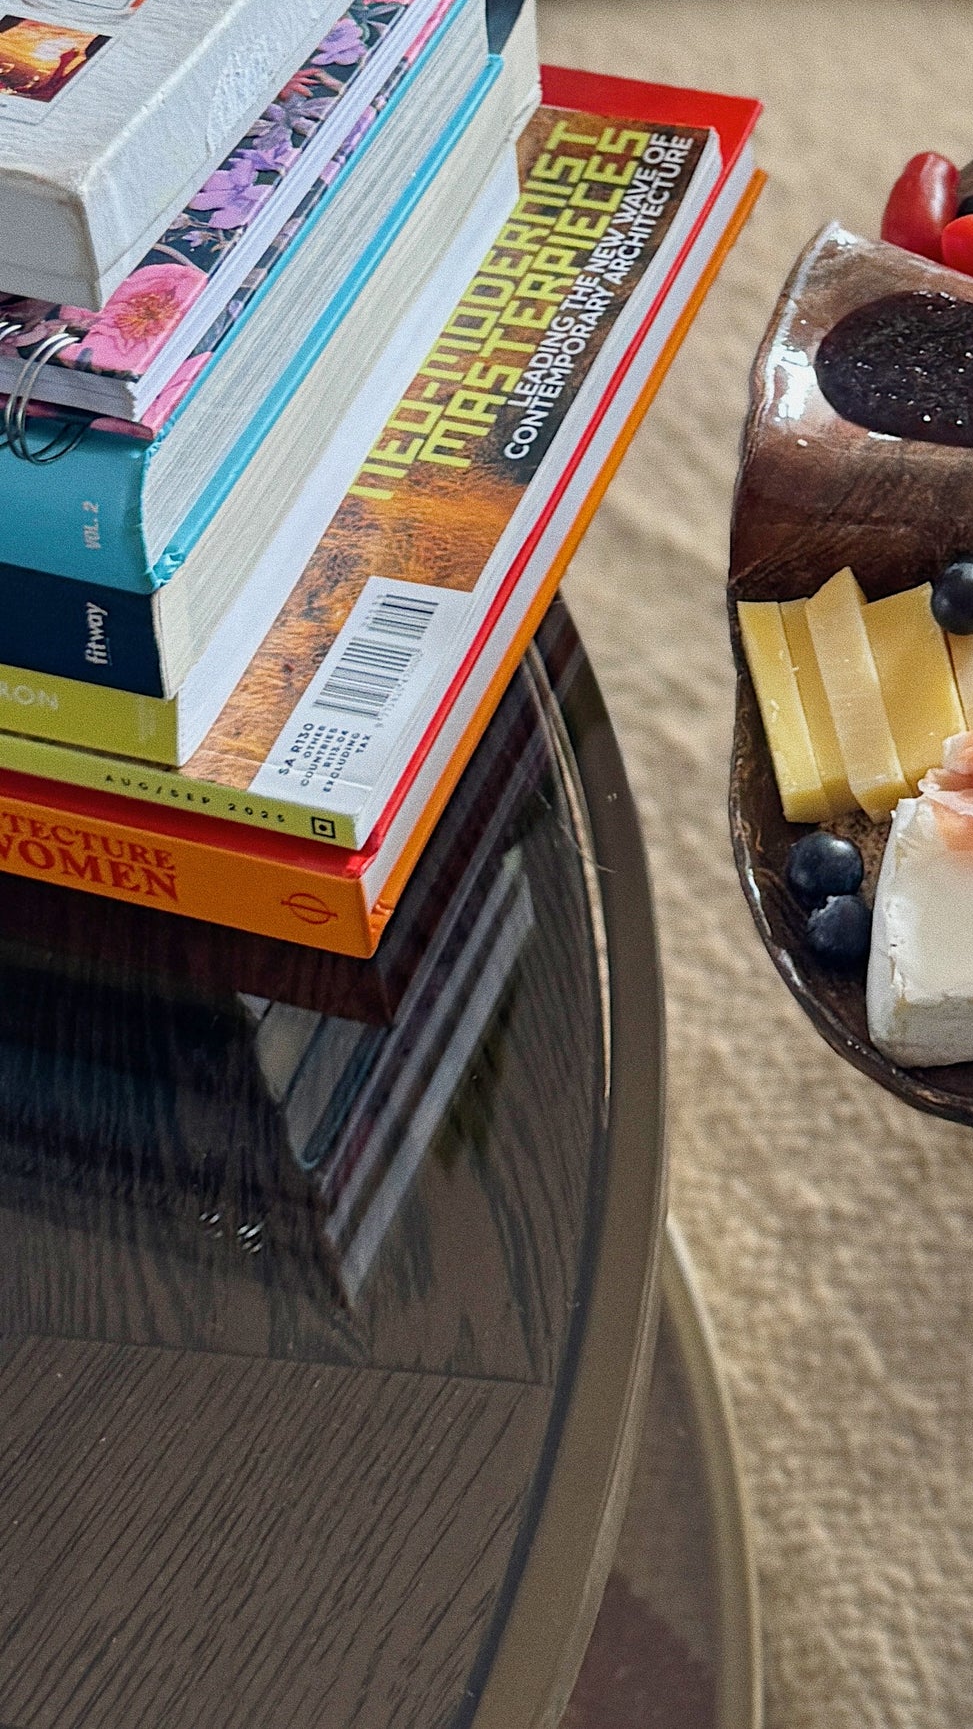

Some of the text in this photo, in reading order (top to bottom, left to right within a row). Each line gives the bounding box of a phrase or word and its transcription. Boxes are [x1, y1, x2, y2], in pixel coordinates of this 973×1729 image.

[417, 127, 653, 468] MASTERPIECES
[504, 136, 694, 460] CONTEMPORARY ARCHITECTURE
[508, 132, 671, 408] LEADING THE NEW WAVE OF
[82, 500, 99, 513] 2
[84, 601, 108, 665] fitway
[279, 723, 314, 775] SA R130
[301, 728, 338, 787] COUNTRIES
[303, 725, 326, 758] OTHER
[323, 732, 360, 792] EXCLUDING
[355, 735, 372, 753] TAX
[104, 774, 286, 823] AUG/SEP 2025
